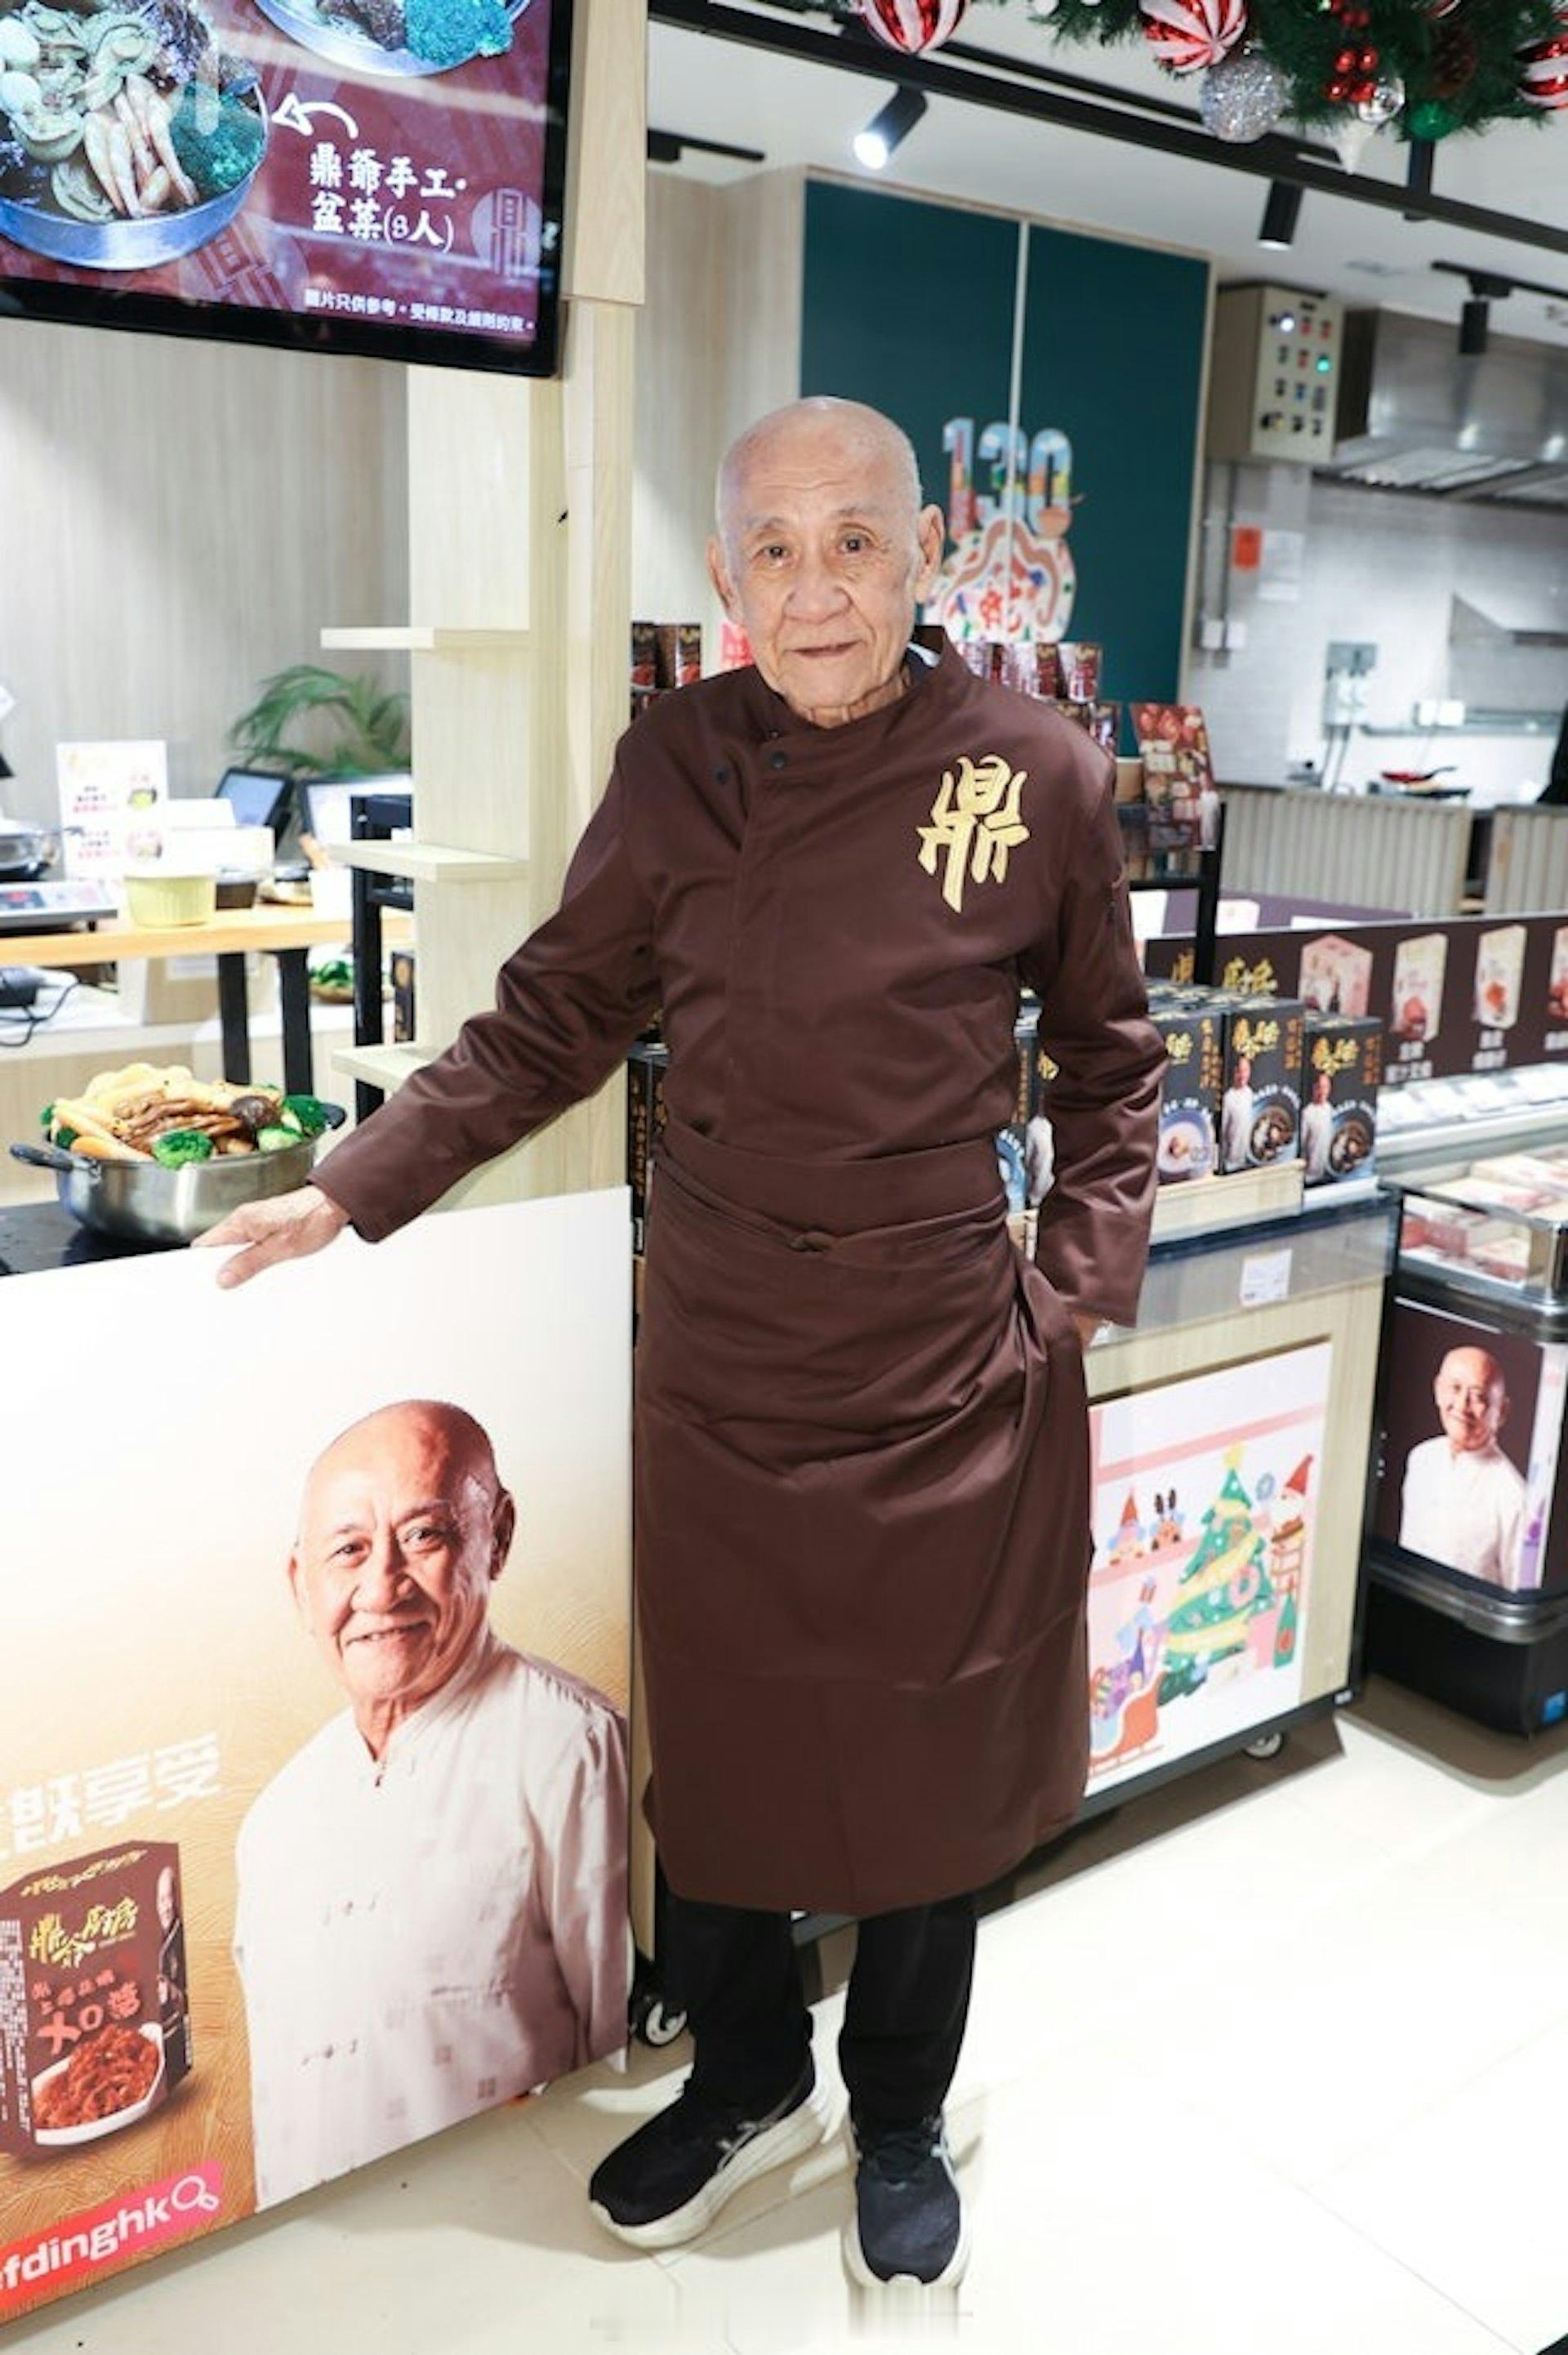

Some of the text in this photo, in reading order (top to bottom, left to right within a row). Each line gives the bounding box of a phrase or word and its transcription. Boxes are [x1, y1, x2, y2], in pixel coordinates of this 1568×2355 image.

[942, 417, 1072, 539] 130
[915, 753, 1030, 914] 鼎
[0, 1731, 222, 1862] 既享受
[0, 2196, 170, 2290] fdinghk
